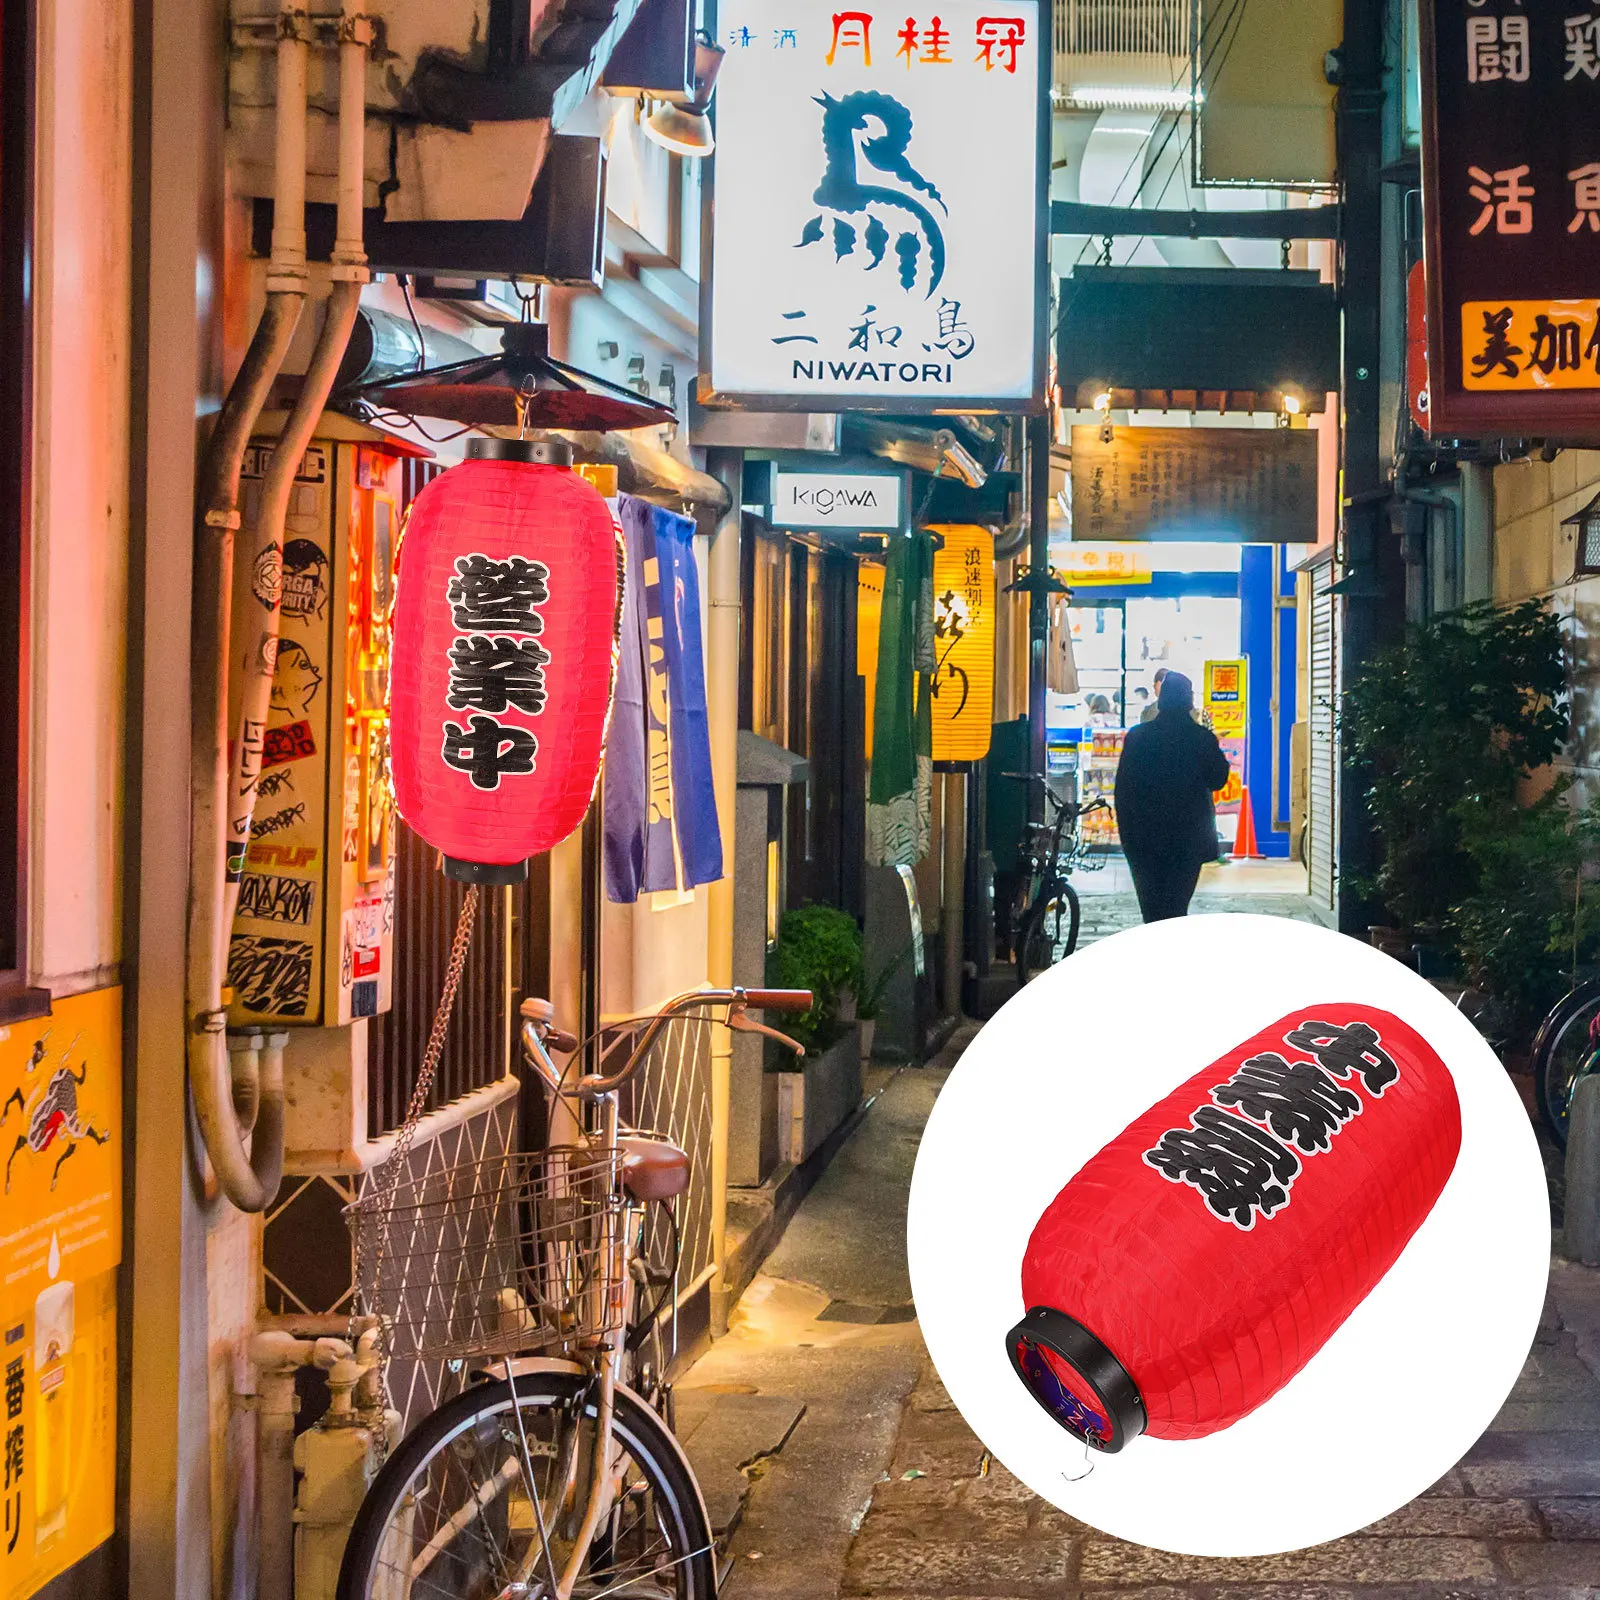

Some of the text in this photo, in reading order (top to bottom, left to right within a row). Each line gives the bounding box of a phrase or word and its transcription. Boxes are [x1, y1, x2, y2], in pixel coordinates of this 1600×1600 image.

[825, 12, 1026, 73] 月桂冠
[771, 297, 975, 360] 二和鳥
[792, 360, 952, 383] NIWATORI
